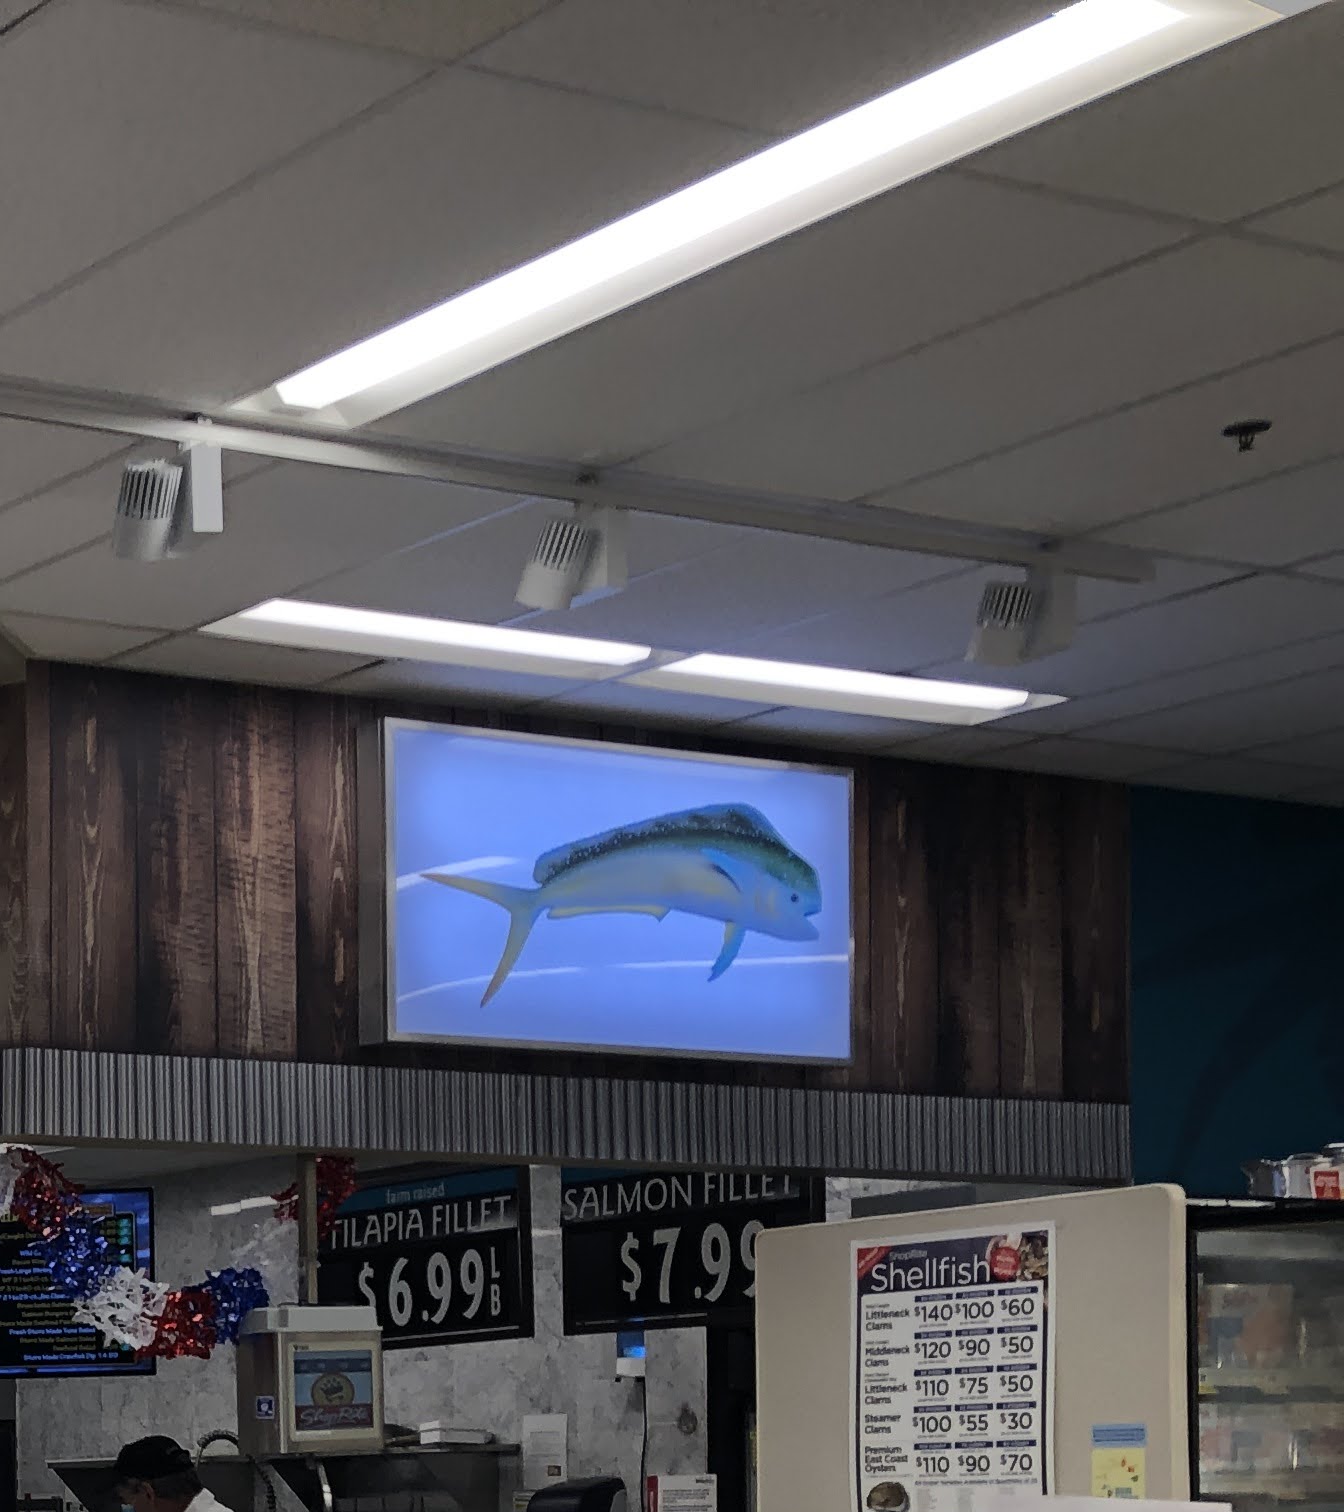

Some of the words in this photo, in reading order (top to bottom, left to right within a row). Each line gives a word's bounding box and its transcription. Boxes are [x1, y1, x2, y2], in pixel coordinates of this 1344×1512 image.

[564, 1174, 694, 1221] SALMON
[330, 1208, 425, 1250] TILAPIA
[432, 1195, 512, 1236] FILLET
[871, 1254, 990, 1291] Shellfish
[865, 1309, 910, 1321] Littleneck
[914, 1304, 953, 1322] $140
[955, 1301, 994, 1319] $100
[1001, 1297, 1034, 1316] $60
[914, 1341, 951, 1358] $120
[958, 1338, 990, 1356] $90
[1001, 1335, 1033, 1353] $50
[864, 1383, 907, 1394] Littleneck
[915, 1378, 949, 1396] $110
[959, 1377, 988, 1394] $75
[1000, 1374, 1033, 1392] $50
[912, 1415, 951, 1433] $100
[959, 1414, 988, 1431] $55
[1000, 1411, 1032, 1430] $30
[865, 1455, 883, 1464] East
[884, 1454, 908, 1463] Coast
[916, 1456, 949, 1473] $110
[958, 1455, 990, 1473] $90
[1000, 1453, 1032, 1471] $70
